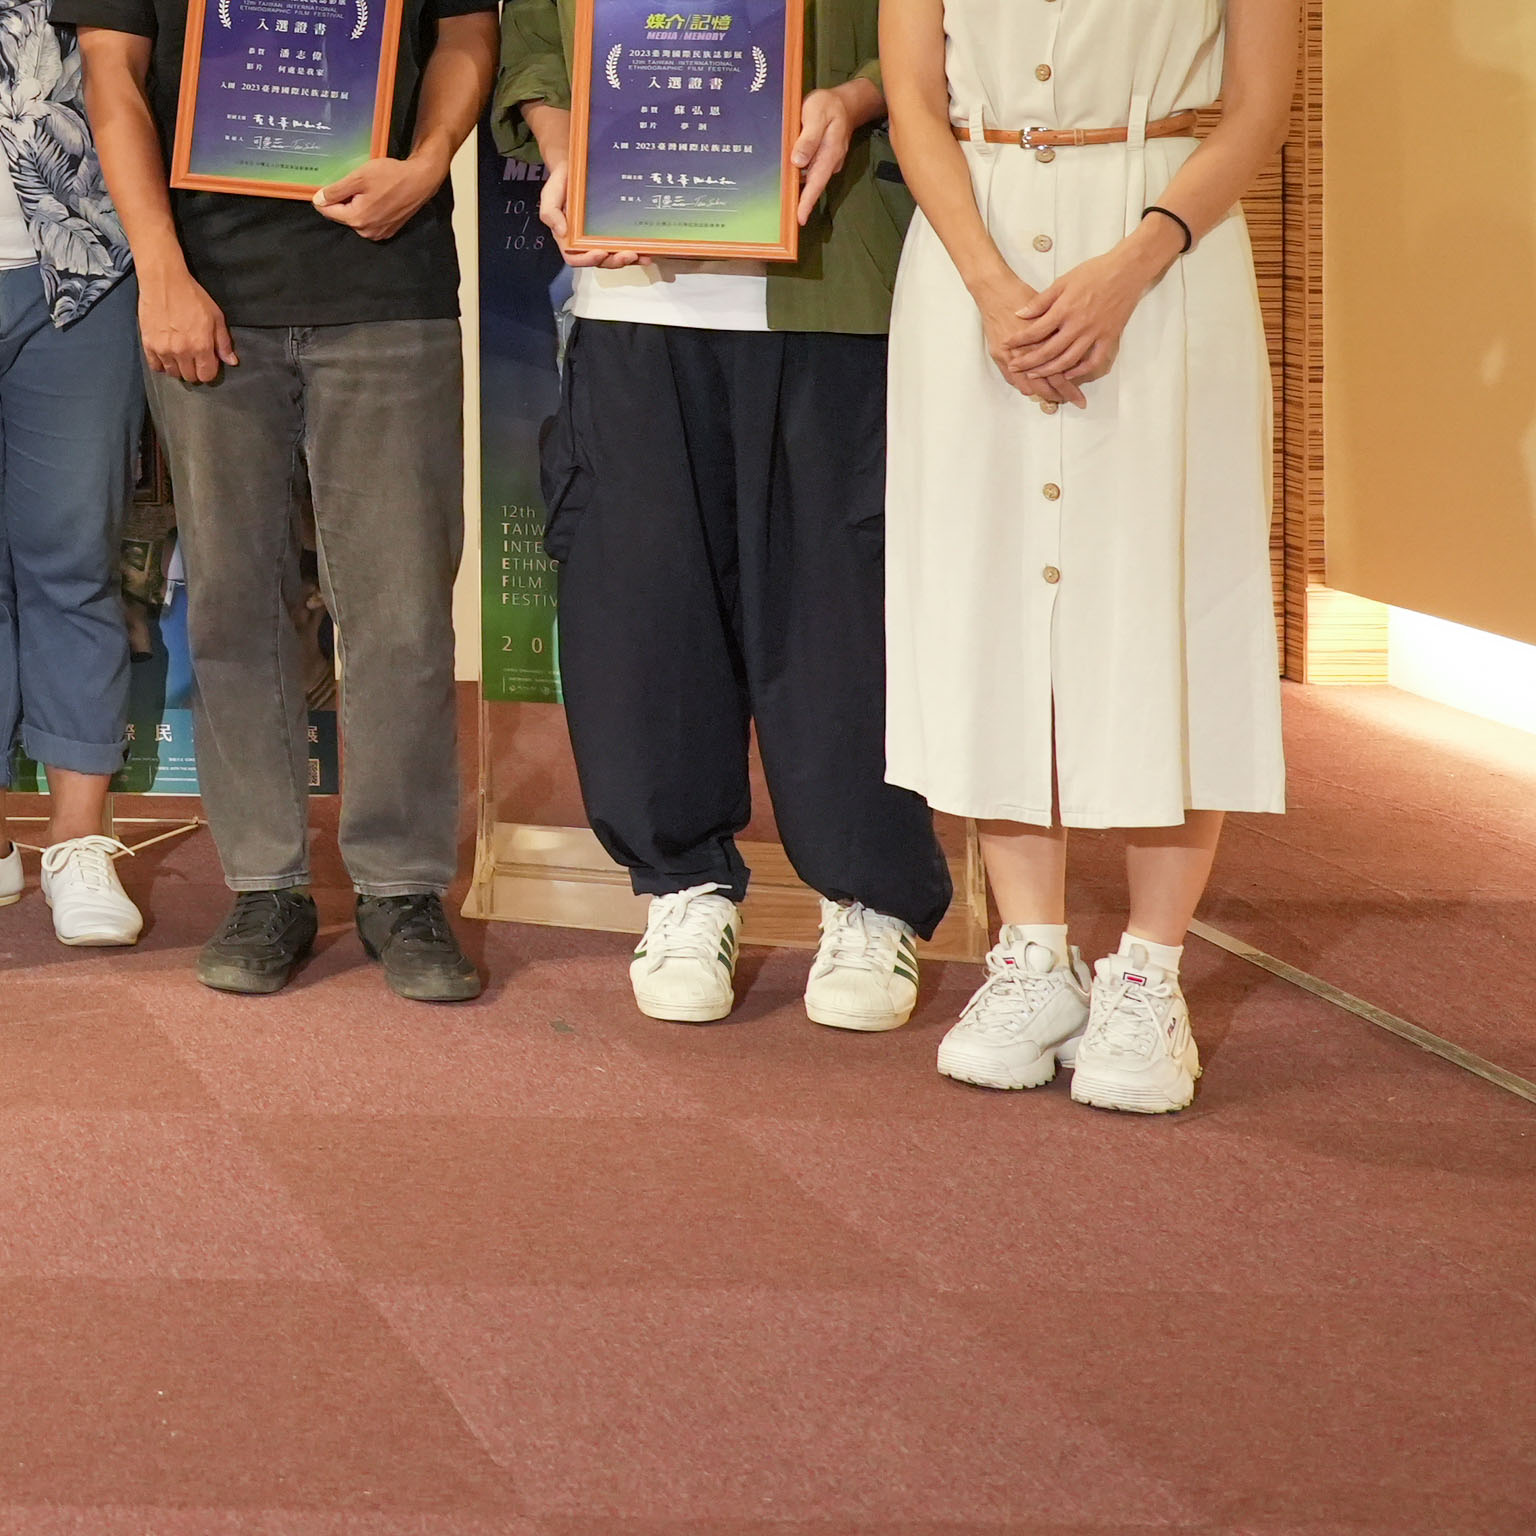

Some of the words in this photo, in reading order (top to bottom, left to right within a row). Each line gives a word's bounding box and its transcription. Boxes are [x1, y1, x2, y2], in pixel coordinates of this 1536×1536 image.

[505, 235, 545, 250] 10.8
[501, 505, 535, 518] 12th
[501, 522, 546, 536] TAIW
[502, 576, 541, 589] FILM
[502, 592, 558, 607] FESTIV
